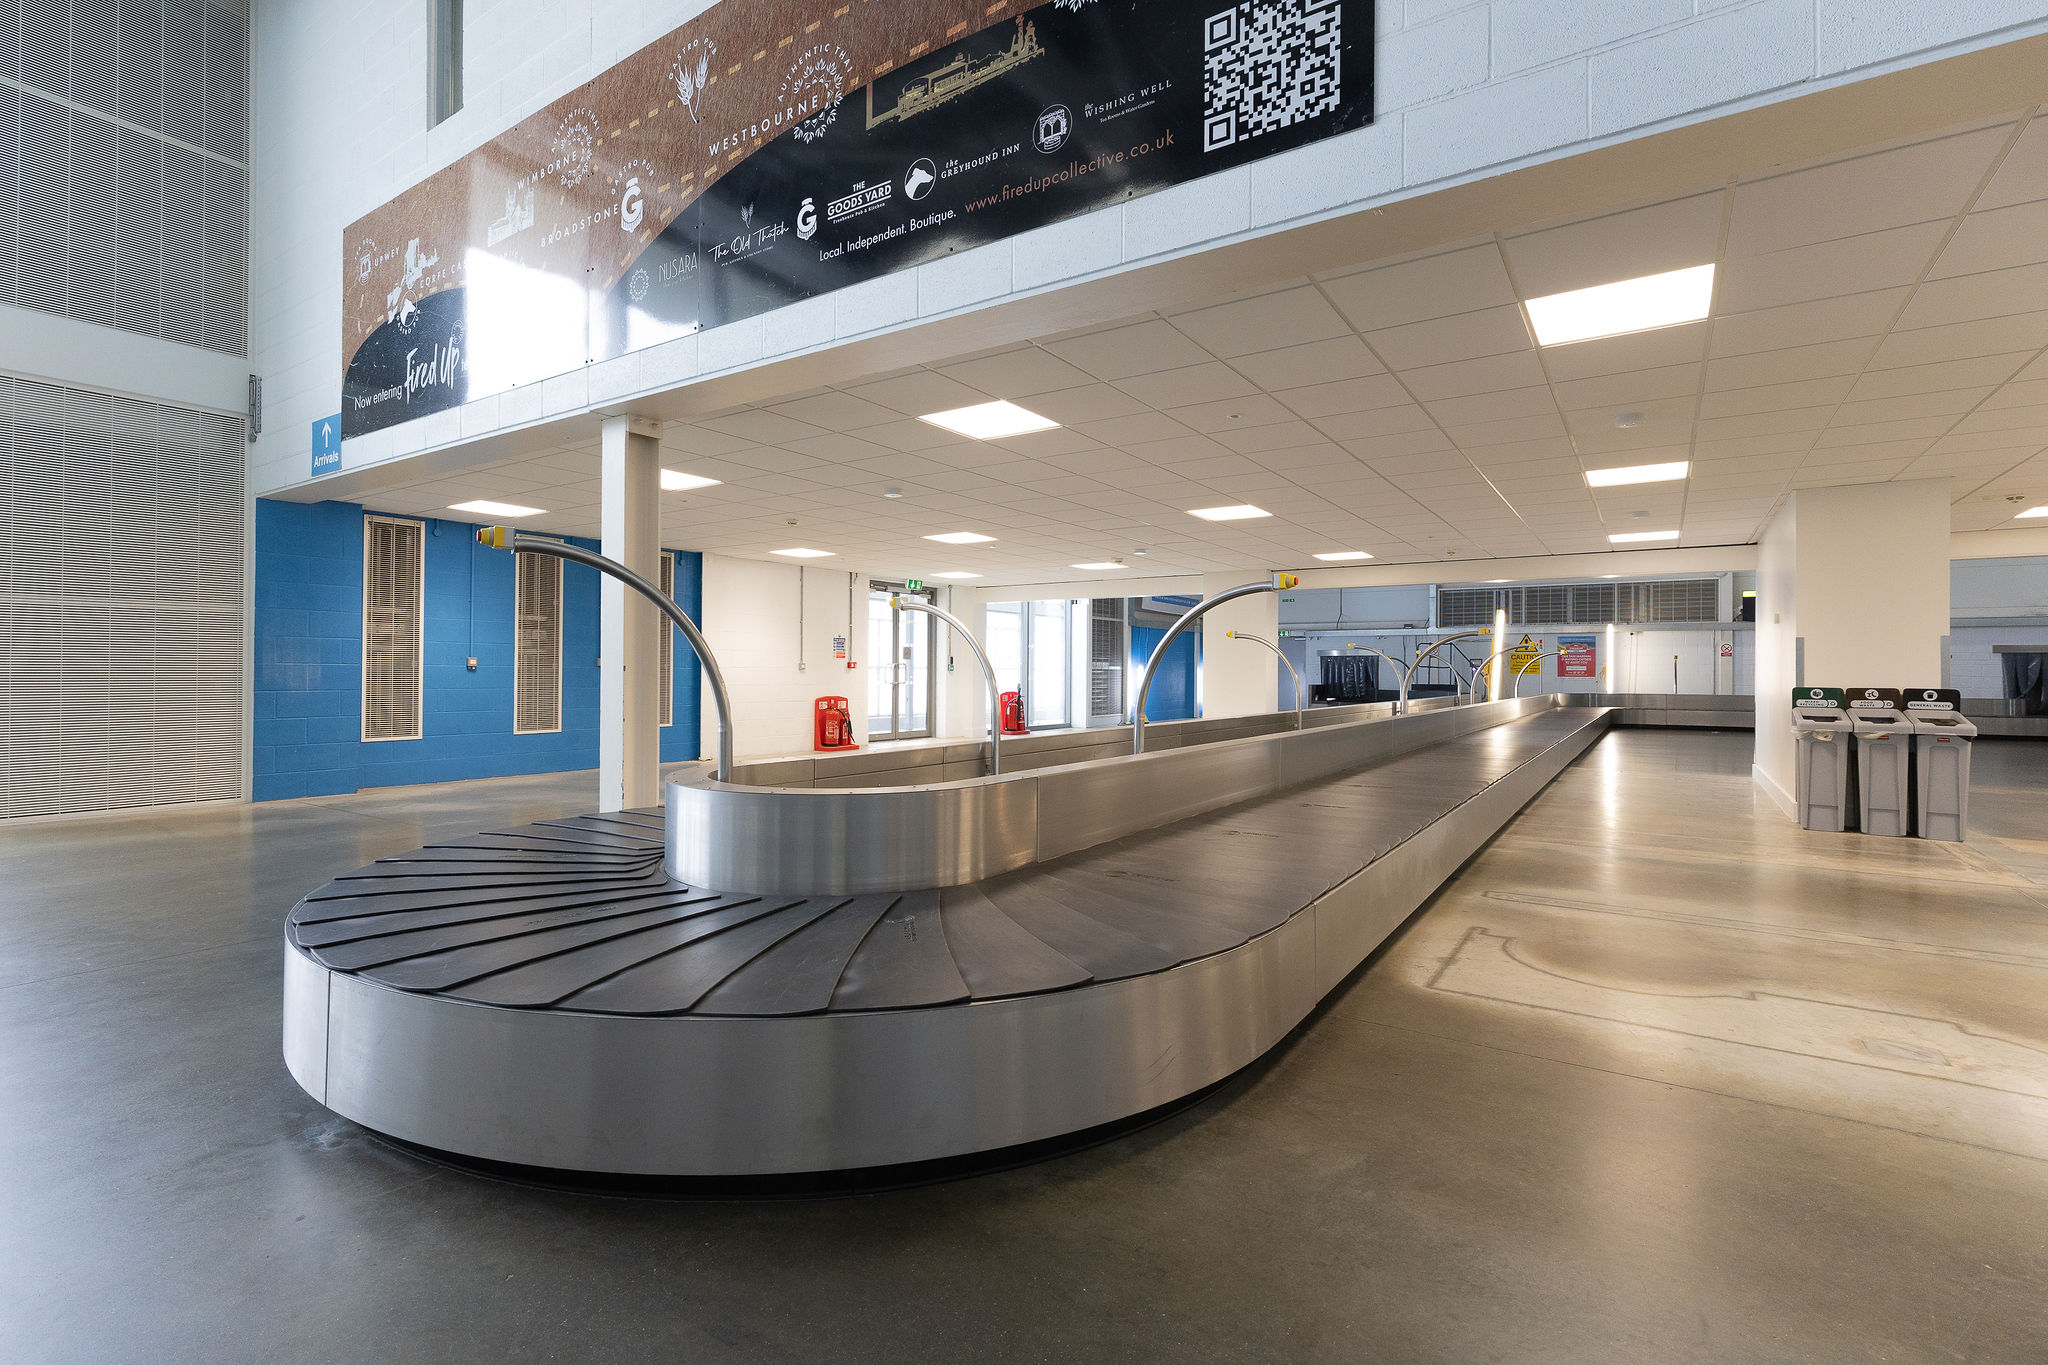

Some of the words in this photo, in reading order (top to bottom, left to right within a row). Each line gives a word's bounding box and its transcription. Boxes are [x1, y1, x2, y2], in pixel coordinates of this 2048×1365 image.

[668, 39, 699, 80] GASTRO
[703, 37, 717, 55] PUB
[777, 43, 830, 102] AUTHENTIC
[834, 46, 854, 73] THAI
[1085, 93, 1135, 118] WISHING
[1140, 80, 1172, 97] WELL
[709, 95, 818, 156] WESTBOURNE
[517, 151, 577, 190] WIMBORNE
[941, 151, 999, 179] GREYHOUND
[1002, 143, 1020, 157] INN
[945, 159, 959, 169] the
[965, 128, 1175, 213] www.firedupcollective.co.uk
[828, 194, 863, 216] GOODS
[865, 184, 892, 202] YARD
[853, 180, 866, 192] THE
[541, 203, 618, 248] BROADSTONE
[708, 242, 730, 263] The
[731, 234, 751, 255] Old
[753, 221, 790, 247] Thatch
[819, 242, 845, 262] Local.
[847, 223, 907, 252] Independent.
[910, 209, 957, 231] Boutique.
[374, 246, 399, 267] UPWEY
[658, 251, 698, 283] NUSARA
[420, 268, 446, 289] CORFE
[354, 394, 371, 411] Now
[373, 384, 403, 404] entering
[404, 343, 438, 405] Fired
[440, 336, 460, 390] Up
[313, 450, 339, 468] Arrivals
